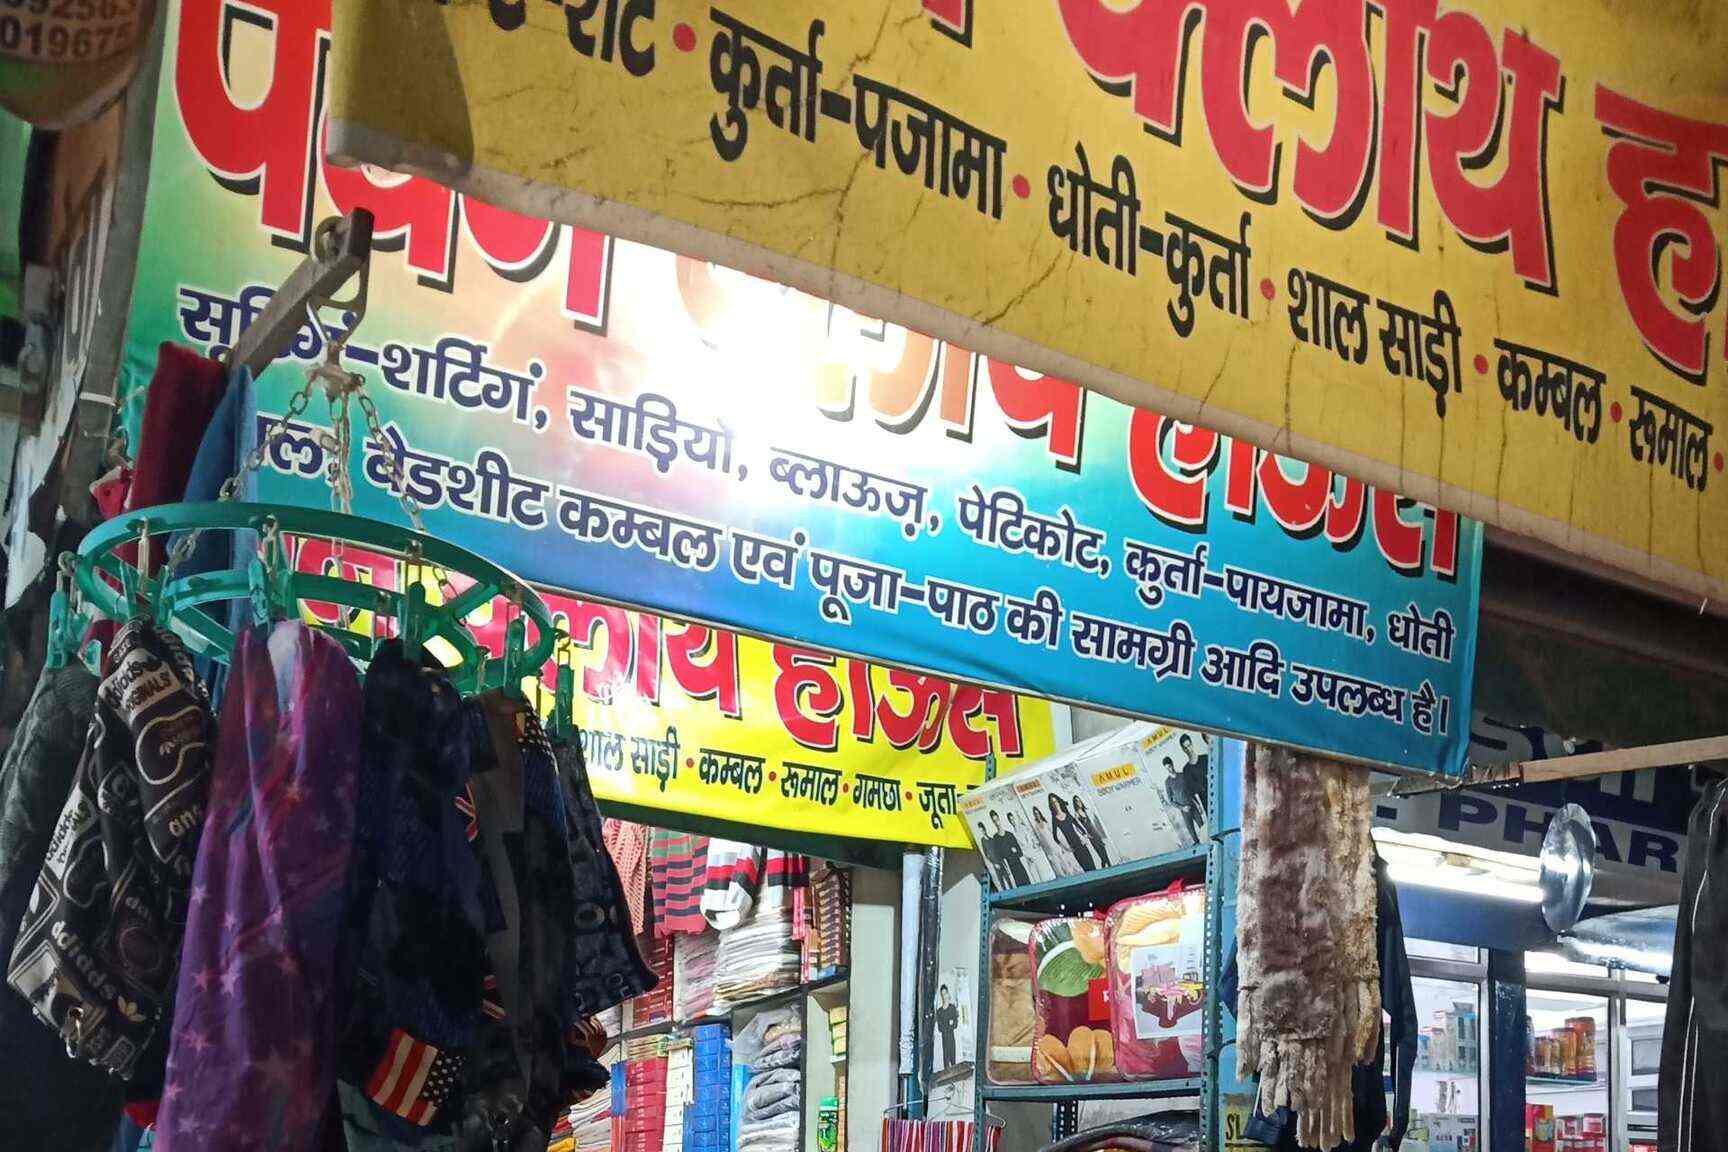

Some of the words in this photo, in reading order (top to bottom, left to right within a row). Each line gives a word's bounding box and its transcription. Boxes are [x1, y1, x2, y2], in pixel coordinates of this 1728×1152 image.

[1047, 141, 1252, 338] धोती-कुर्ता
[1286, 265, 1370, 365] शाल
[1376, 290, 1462, 420] साड़ी
[1493, 337, 1607, 444] कम्बल
[1629, 384, 1714, 492] रूमाल
[559, 487, 722, 567] कम्बल
[731, 531, 806, 585] एवं
[811, 551, 1000, 622] पूजा-पाठ
[1007, 592, 1060, 648] की
[1071, 614, 1196, 681] सामग्री
[1202, 642, 1285, 697] आदि
[1291, 665, 1405, 723] उपलब्ध
[958, 484, 1109, 577] पेटिकोट,
[1388, 604, 1455, 660] धोती
[699, 747, 766, 794] कम्बल
[780, 760, 842, 805] रूमाल
